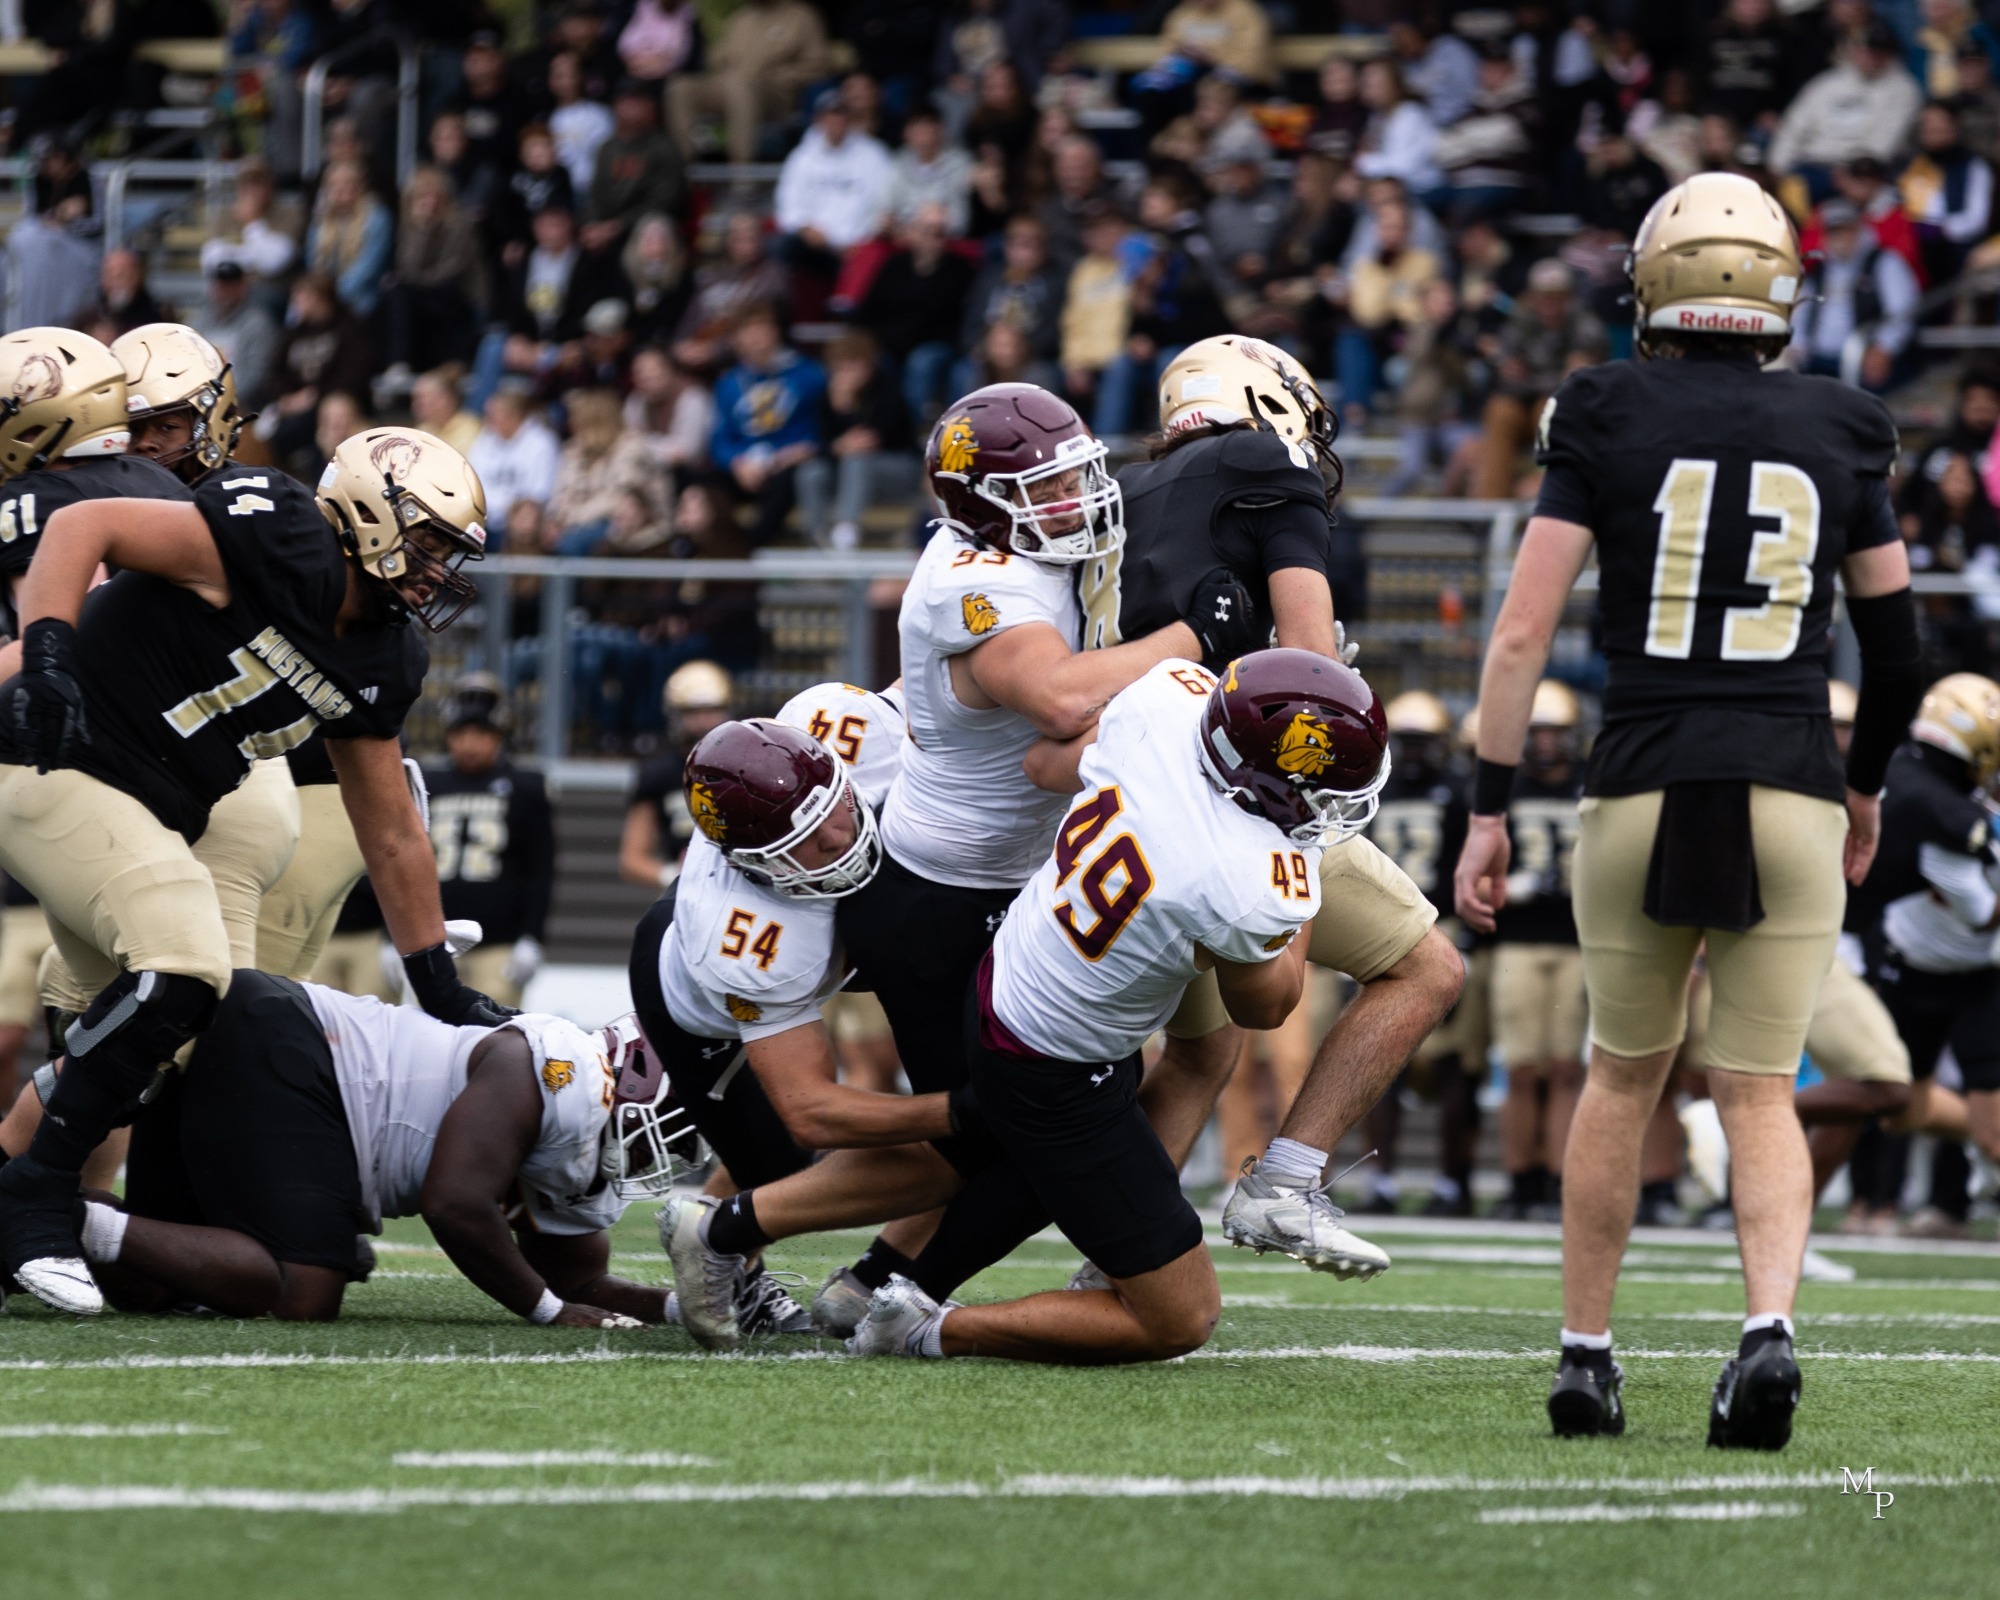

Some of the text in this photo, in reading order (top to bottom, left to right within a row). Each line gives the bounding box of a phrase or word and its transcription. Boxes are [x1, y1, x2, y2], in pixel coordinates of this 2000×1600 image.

[1679, 311, 1764, 333] Riddell
[0, 493, 38, 543] 61
[1645, 459, 1820, 661] 13
[247, 625, 354, 720] MUSTANGS
[808, 708, 868, 766] 54
[1054, 784, 1155, 963] 49
[1271, 851, 1311, 901] 49
[719, 907, 784, 972] 54
